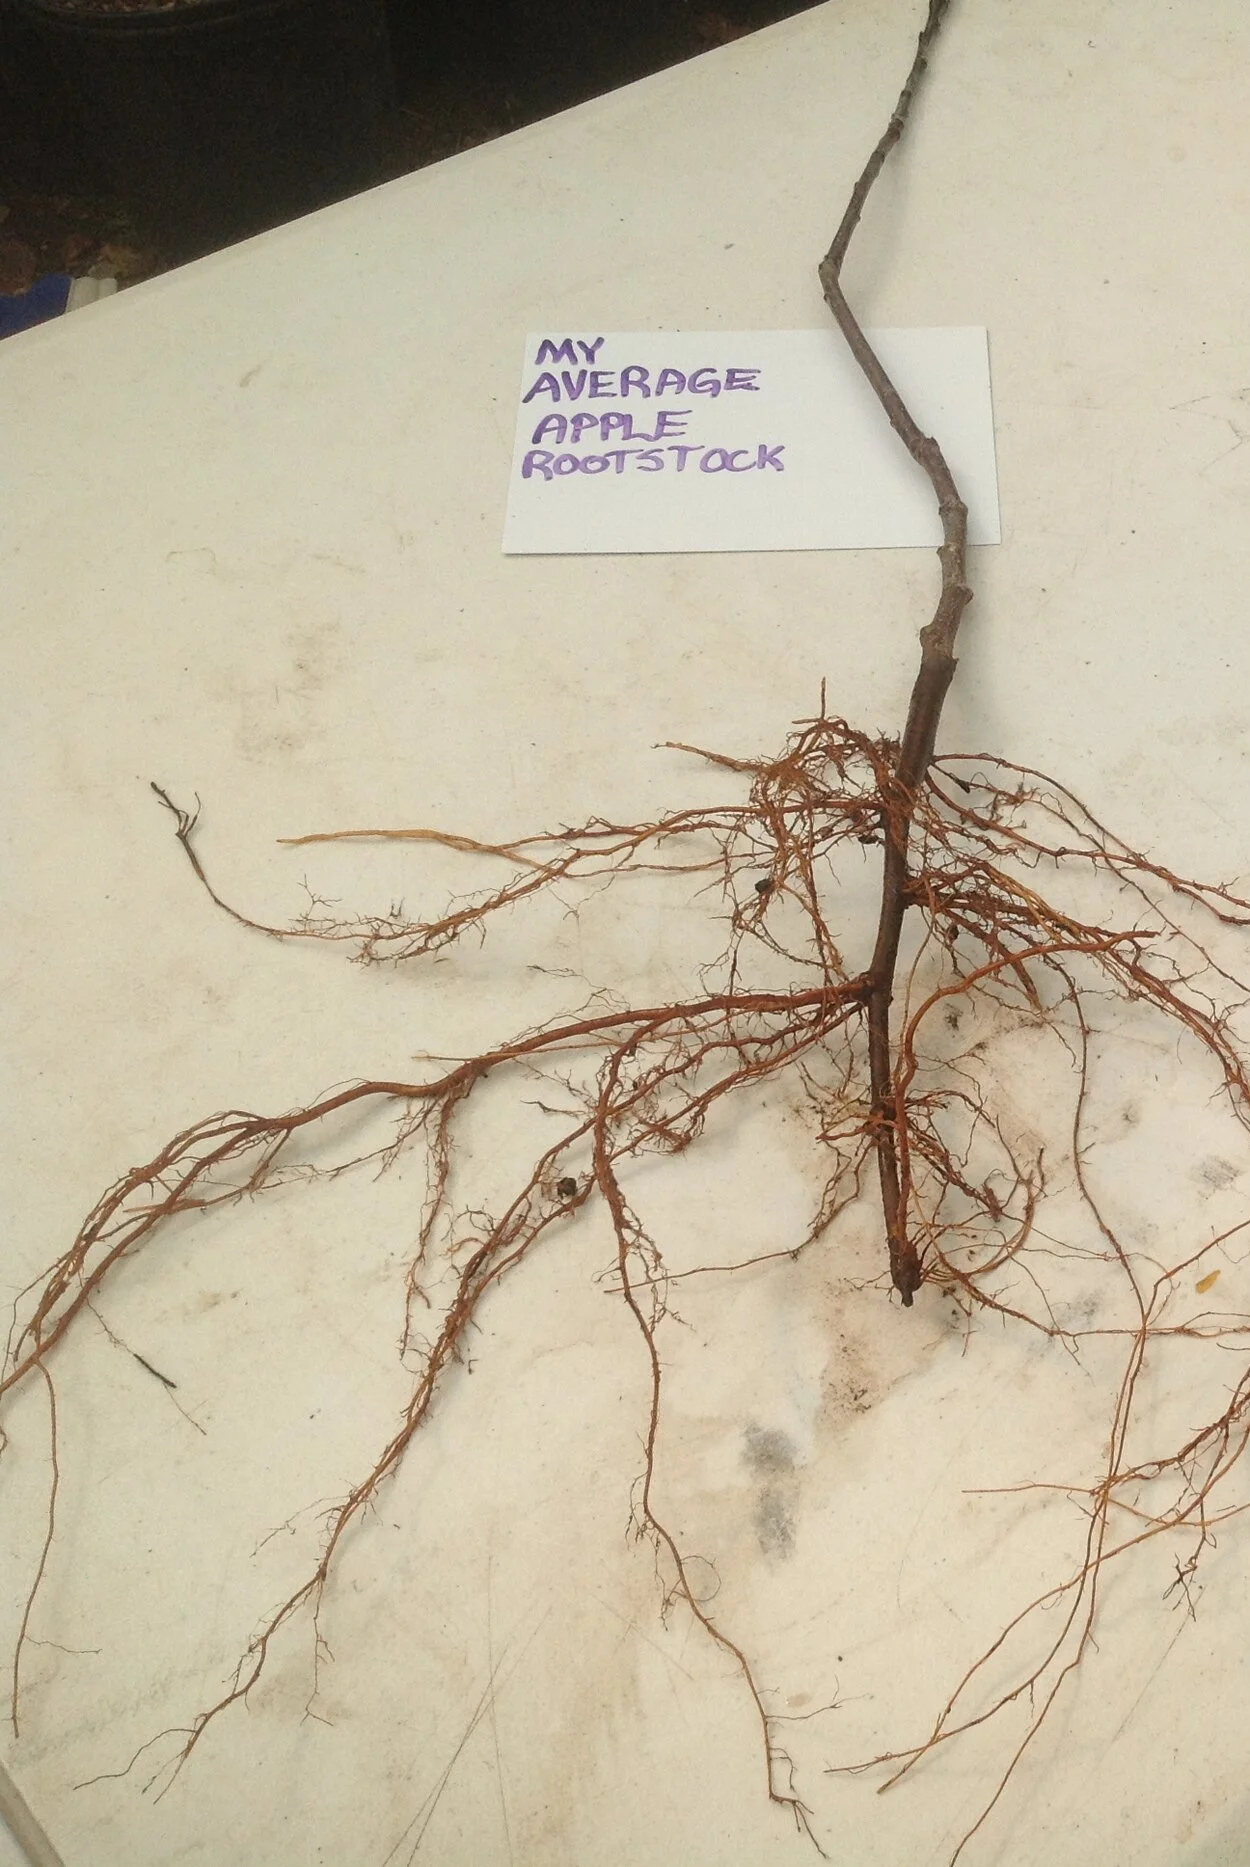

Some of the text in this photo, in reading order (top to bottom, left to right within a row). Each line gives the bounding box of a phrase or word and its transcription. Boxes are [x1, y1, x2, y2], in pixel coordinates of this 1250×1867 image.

[534, 336, 605, 366] MY
[521, 365, 762, 404] AVERAGE
[531, 409, 693, 444] APPLE
[521, 444, 785, 481] ROOTSTOCK
